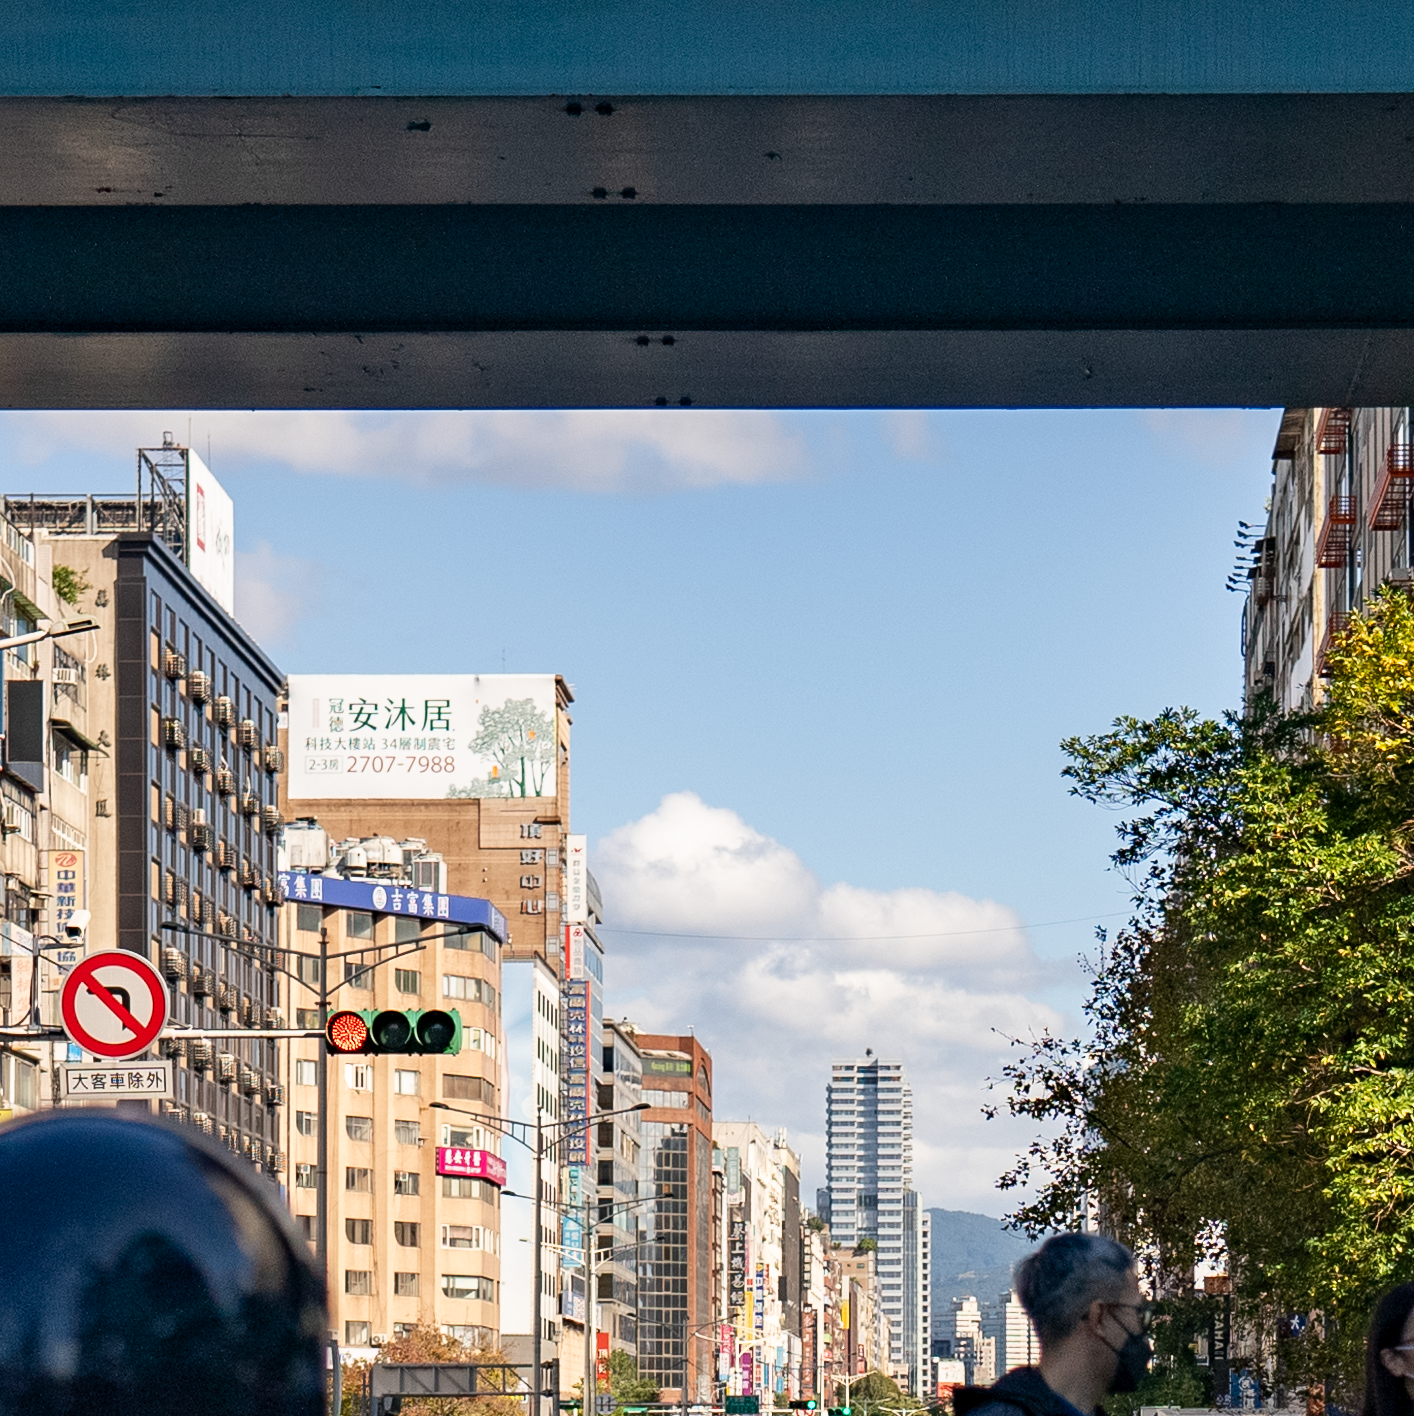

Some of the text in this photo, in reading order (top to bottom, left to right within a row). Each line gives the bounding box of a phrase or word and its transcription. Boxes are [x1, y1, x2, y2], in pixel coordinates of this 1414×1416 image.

[329, 698, 452, 732] 冠德 安沐居
[305, 737, 376, 750] 科技大樓站
[347, 756, 455, 773] 2707-7988
[391, 889, 450, 918] 吉富集團
[71, 1071, 163, 1090] 大客車除外
